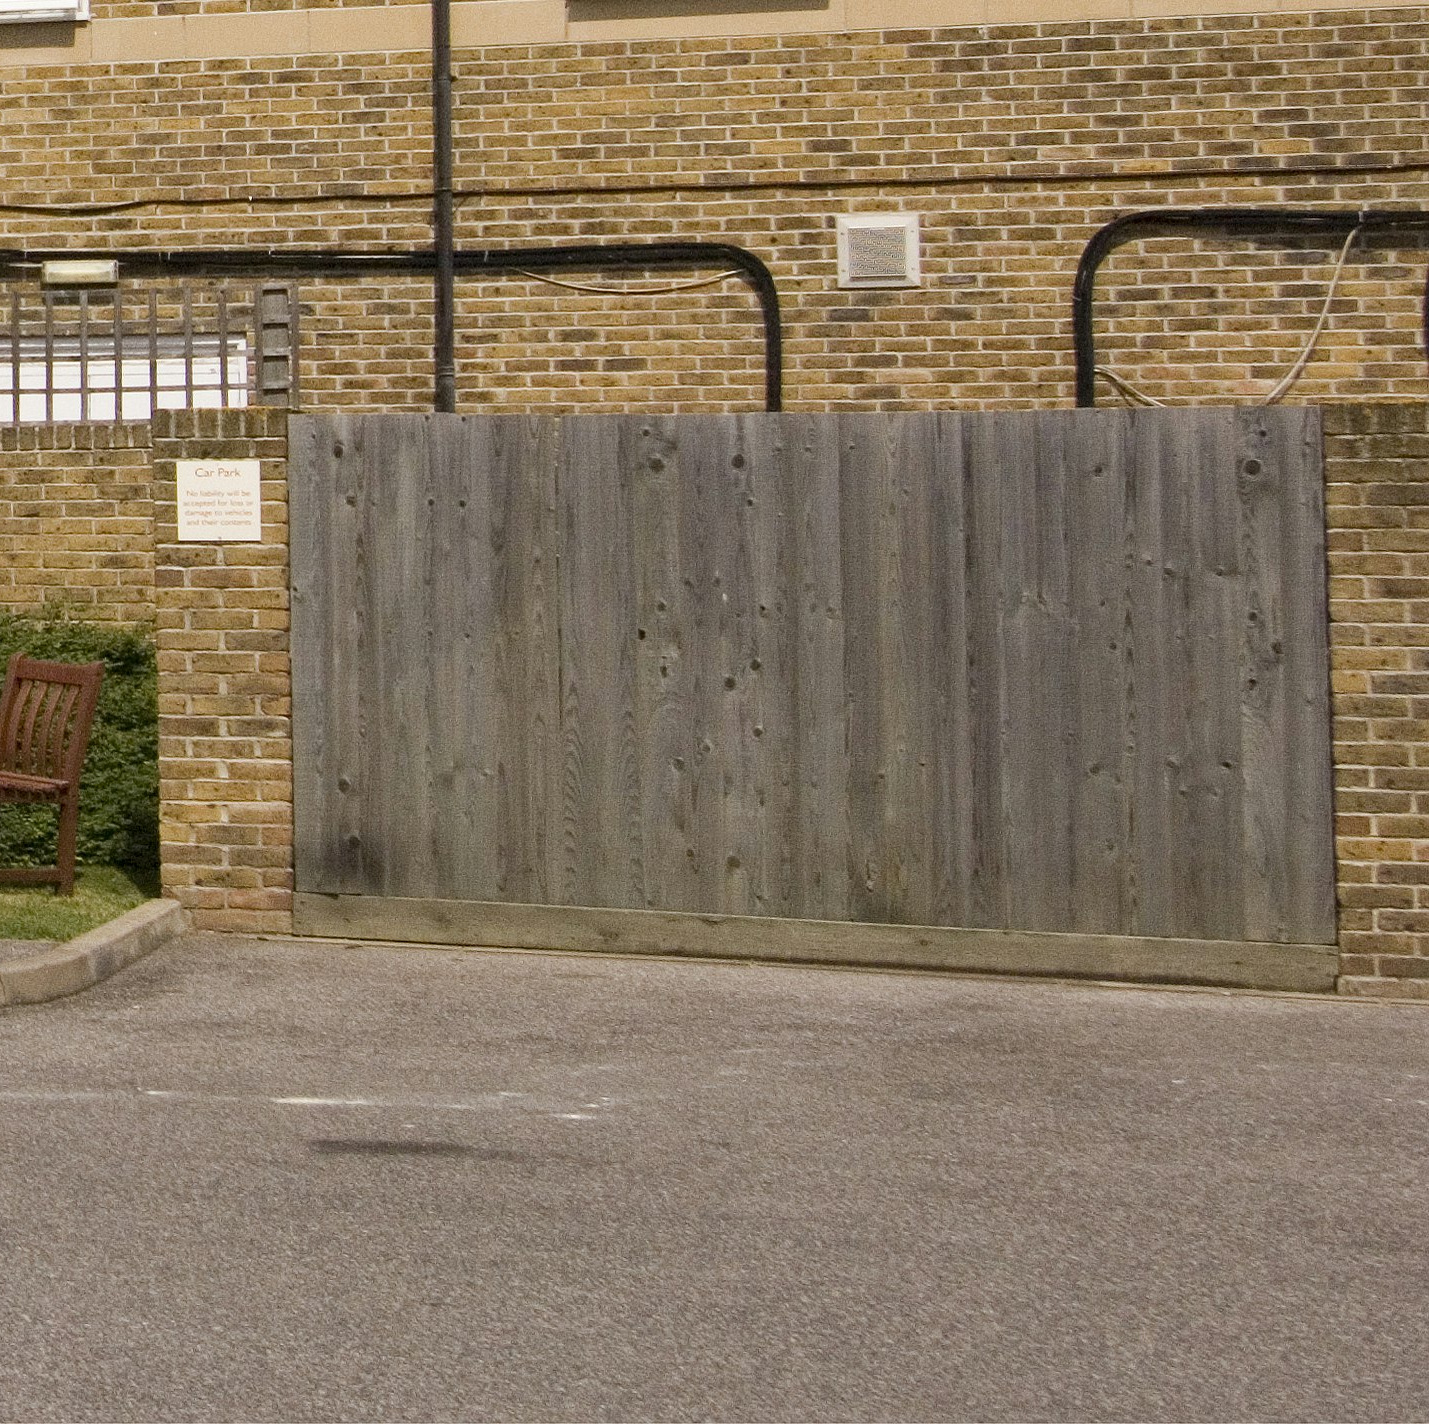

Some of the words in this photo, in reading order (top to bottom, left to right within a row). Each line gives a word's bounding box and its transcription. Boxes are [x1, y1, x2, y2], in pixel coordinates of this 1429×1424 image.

[194, 467, 216, 478] Car
[217, 467, 241, 478] Park
[199, 489, 225, 498] liability
[226, 489, 240, 497] will
[241, 489, 251, 497] be
[183, 499, 216, 508] accepted
[217, 499, 228, 507] for
[230, 499, 244, 507] loss
[184, 509, 213, 518] damage
[224, 509, 253, 517] vehicles
